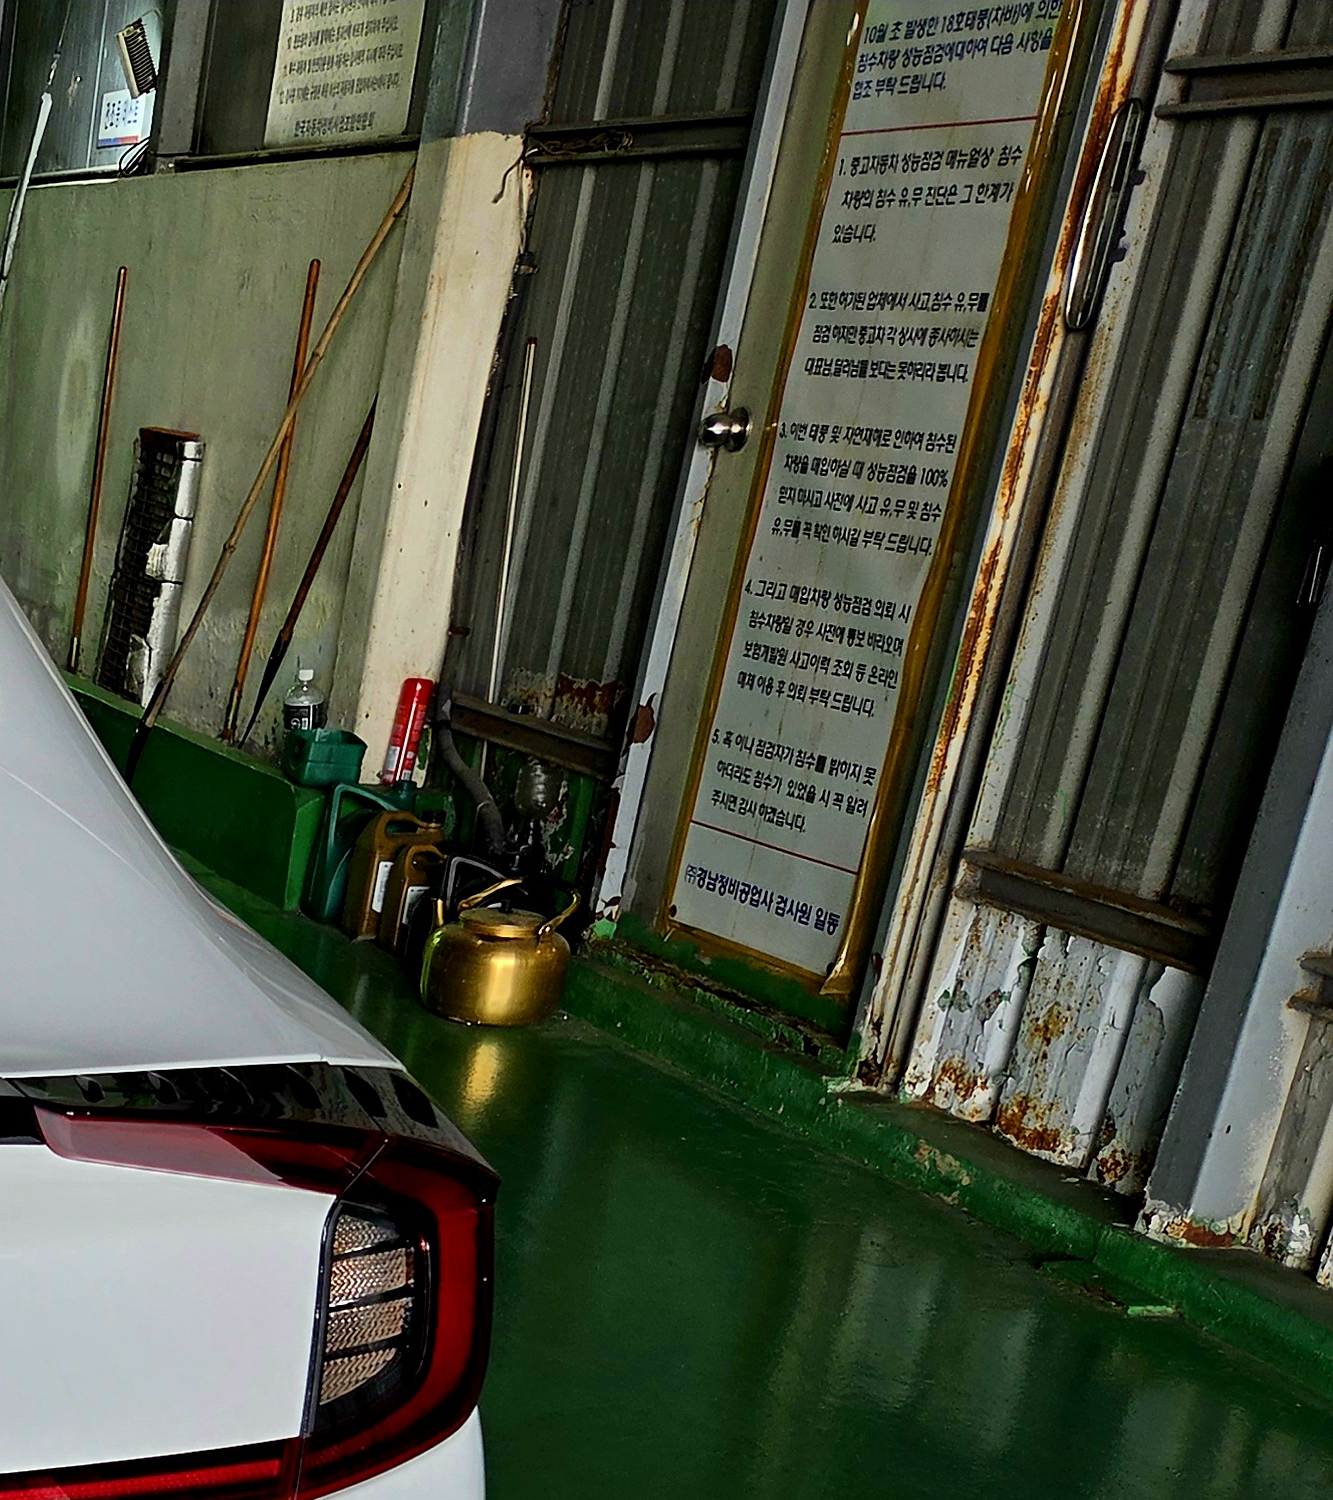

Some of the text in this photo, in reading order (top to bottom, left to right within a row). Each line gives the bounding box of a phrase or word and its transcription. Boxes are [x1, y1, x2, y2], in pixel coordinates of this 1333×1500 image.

[864, 24, 886, 43] 10월
[889, 25, 904, 41] 초
[858, 48, 900, 73] 침수차량
[990, 33, 1013, 56] 다음
[875, 77, 898, 98] 부탁
[899, 71, 946, 94] 드립니다.
[839, 158, 847, 176] 1.
[850, 154, 899, 177] 중고자동차
[901, 150, 944, 173] 성능점검
[996, 145, 1023, 166] 침수
[841, 189, 874, 210] 차량의
[875, 186, 896, 209] 침수
[925, 184, 959, 206] 진단은
[960, 183, 974, 204] 그
[975, 182, 1014, 204] 한계가
[831, 223, 877, 244] 있습니다.
[808, 292, 817, 310] 2.
[820, 291, 838, 311] 또한
[838, 291, 867, 311] 허가된
[867, 291, 908, 312] 업체에서
[812, 324, 980, 348] 점검 하지만 중고차 각 상사에 종사하시는
[869, 360, 897, 380] 보다는
[897, 361, 936, 381] 못하리라
[936, 363, 969, 384] 봅니다.
[779, 422, 958, 454] 3. 이번 태풍 및 자연재해로 인하여 침수된
[784, 453, 949, 488] 차량을 매입하실 때 성능점검을 100%
[797, 489, 823, 508] 마시고
[824, 491, 855, 514] 사전에
[855, 494, 879, 515] 사고
[906, 499, 919, 520] 및
[919, 501, 943, 523] 침수
[802, 521, 813, 540] 꼭
[813, 522, 832, 543] 확인
[832, 525, 862, 548] 하시길
[862, 530, 886, 551] 부탁
[885, 532, 933, 556] 드립니다.
[744, 579, 912, 624] 4. 그리고 매입차량 성능점검 의뢰 시
[748, 610, 904, 657] 침수차량일 경우 사전에 통보 바라오며
[742, 640, 899, 690] 보험개발원 사고이력 조회 등 온라인
[756, 675, 774, 696] 이용
[775, 679, 786, 697] 후
[786, 682, 808, 703] 의뢰
[808, 687, 832, 708] 부탁
[830, 691, 875, 718] 드립니다.
[711, 728, 877, 787] 5. 혹 이나 점검자가 침수를 밝히지 못
[716, 760, 869, 818] 하더라도 침수가 있었을 시 꼭 알려
[711, 789, 806, 834] 주시면 감사 하겠습니다.
[775, 894, 813, 926] 검사원
[814, 907, 840, 935] 일동
